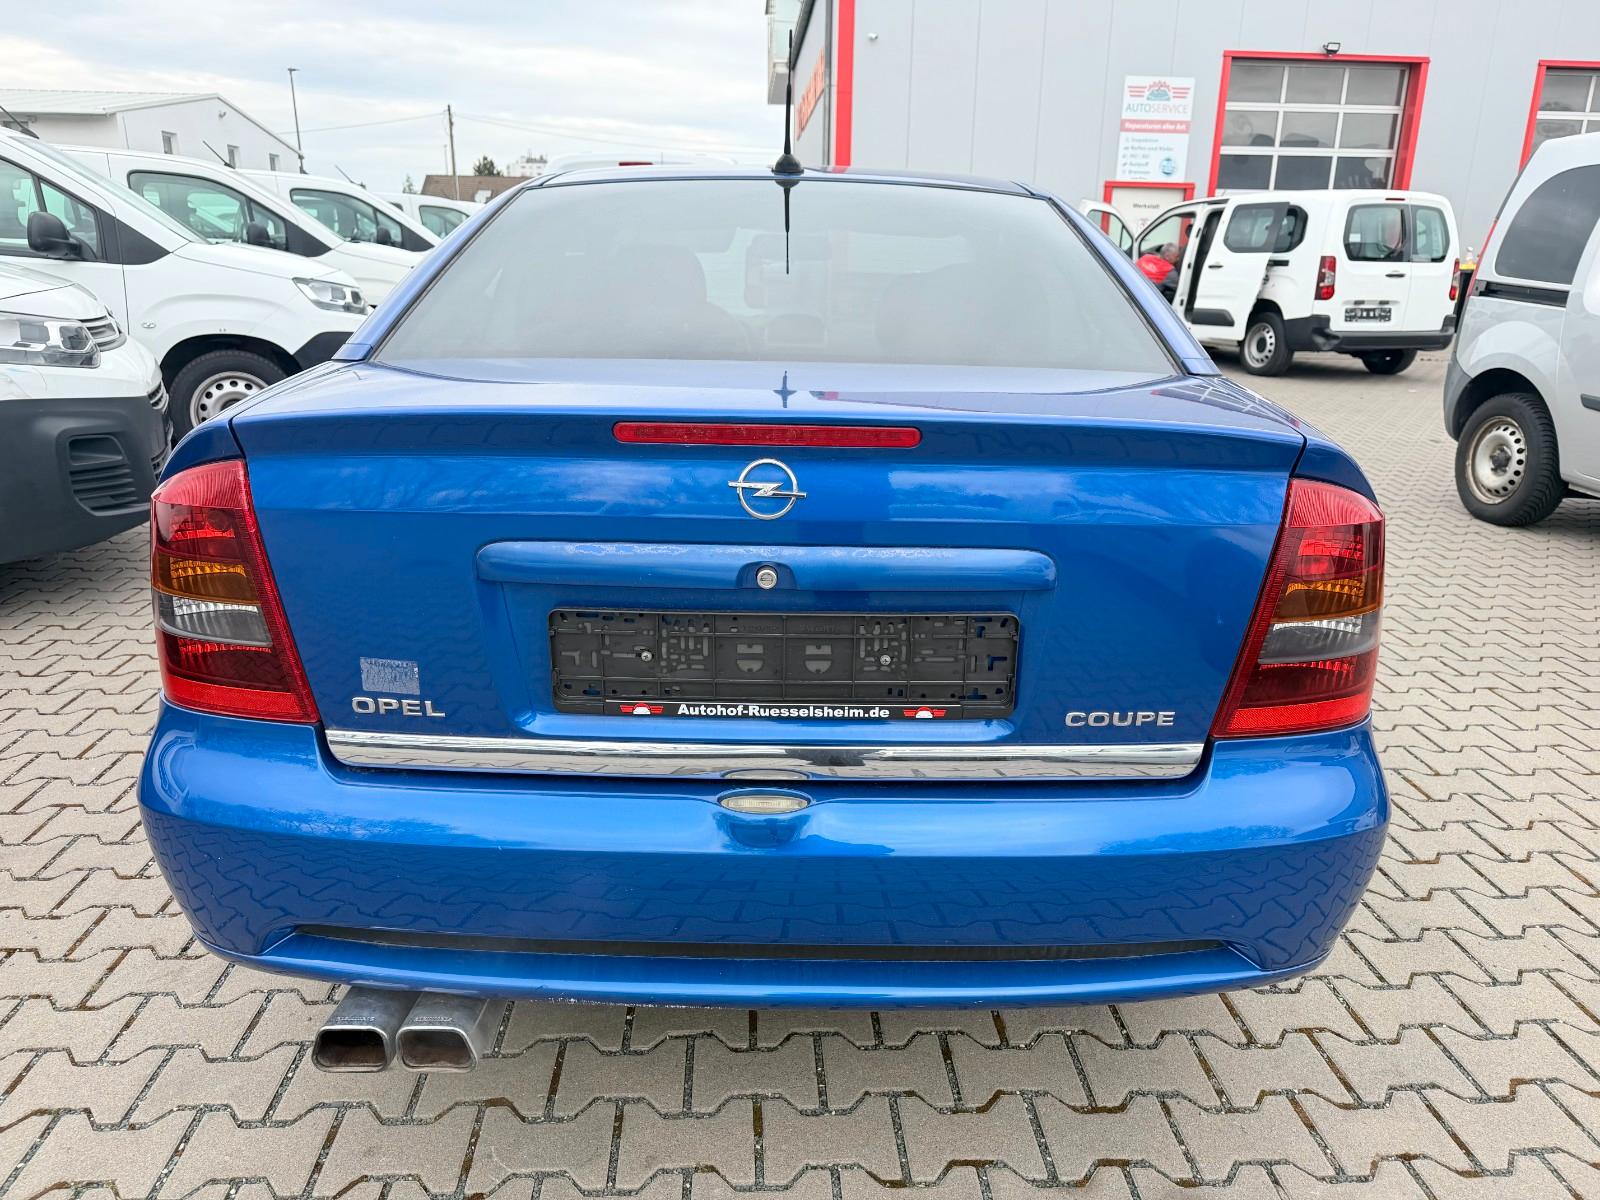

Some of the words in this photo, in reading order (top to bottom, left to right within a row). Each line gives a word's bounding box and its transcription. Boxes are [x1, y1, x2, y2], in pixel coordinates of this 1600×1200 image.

[1125, 103, 1189, 114] AUTOSERVICE
[1125, 122, 1160, 130] Reparaturen
[1176, 123, 1187, 131] Art
[352, 697, 446, 717] OPEL
[678, 703, 890, 718] Autohof-Ruesselsheim.de
[1065, 711, 1176, 727] COUPE
